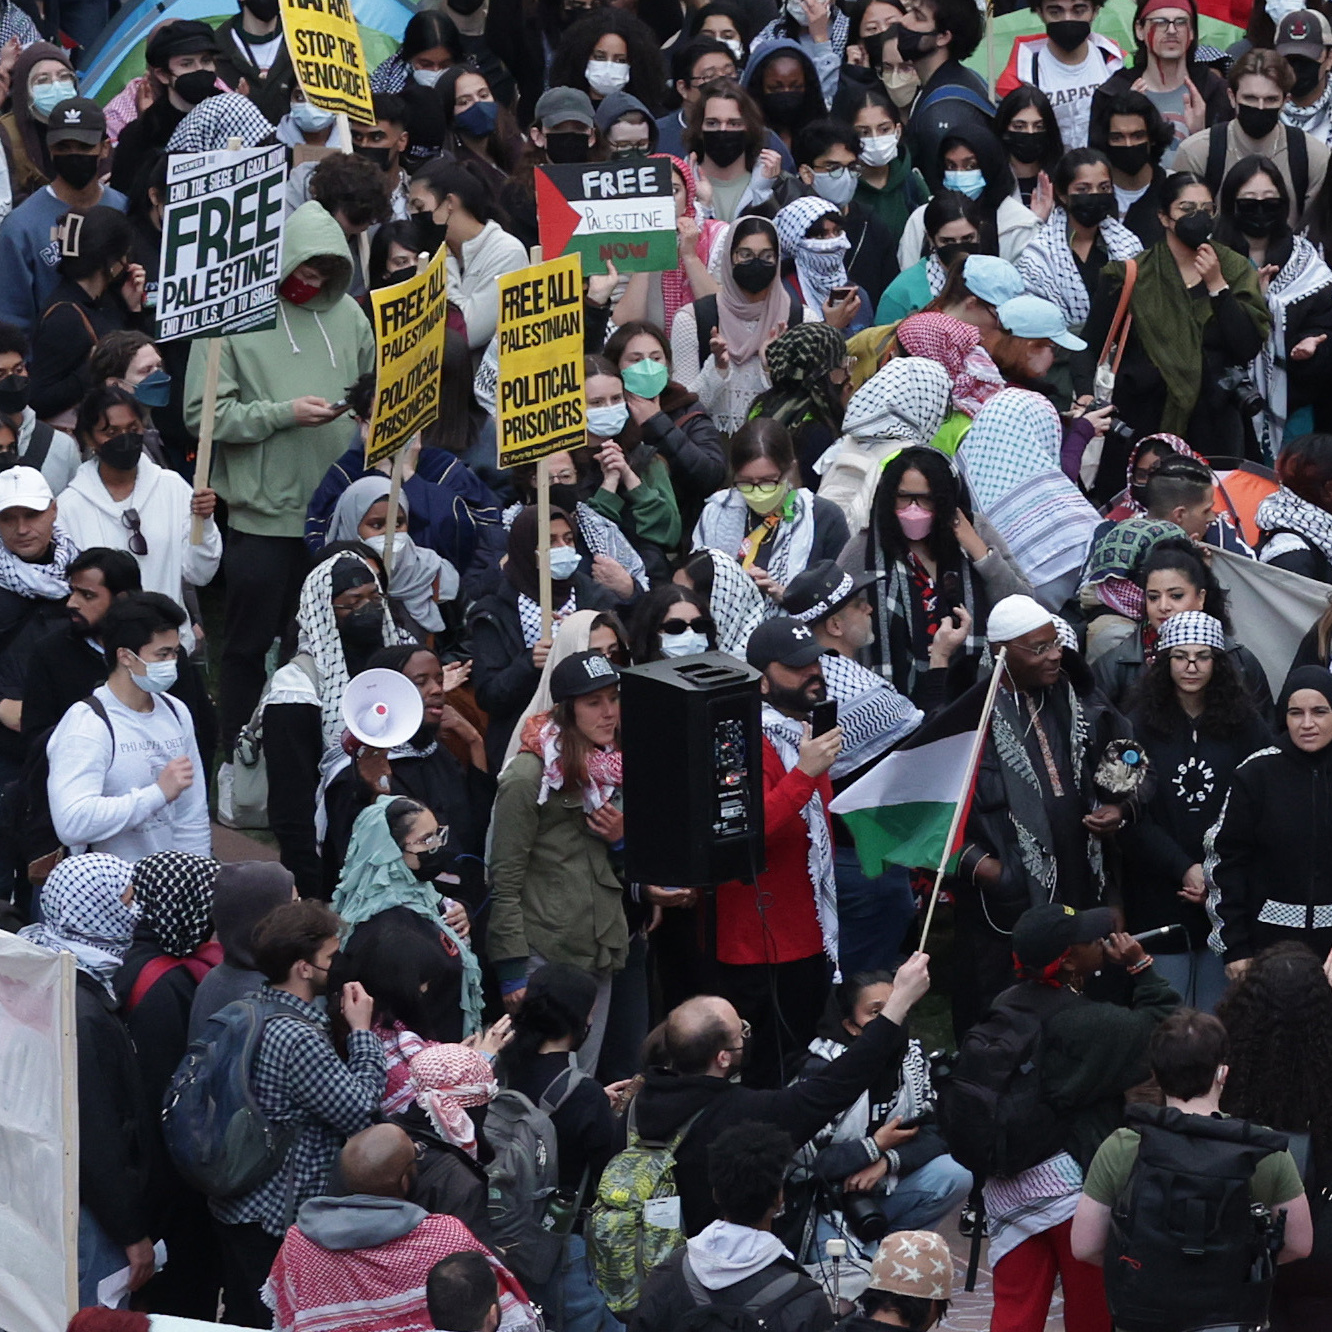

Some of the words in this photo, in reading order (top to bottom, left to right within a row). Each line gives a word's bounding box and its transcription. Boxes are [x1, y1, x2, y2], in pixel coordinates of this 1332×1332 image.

[295, 28, 336, 62] STOP
[297, 61, 369, 103] GENOCIDE!
[190, 177, 207, 197] THE
[582, 166, 660, 199] FREE
[164, 167, 284, 280] FREE
[584, 206, 665, 230] PALESTINE
[599, 241, 650, 262] NOW
[162, 242, 279, 315] PALESTINE!
[501, 277, 544, 324] FREE
[547, 269, 580, 309] ALL
[237, 295, 248, 316] TO
[380, 290, 425, 340] FREE
[381, 298, 446, 368] PALESTINIAN
[501, 310, 580, 357] PALESTINIAN
[377, 345, 440, 419] POLITICAL
[501, 361, 581, 412] POLITICAL
[371, 378, 439, 448] PRISONERS
[502, 399, 583, 447] PRISONERS
